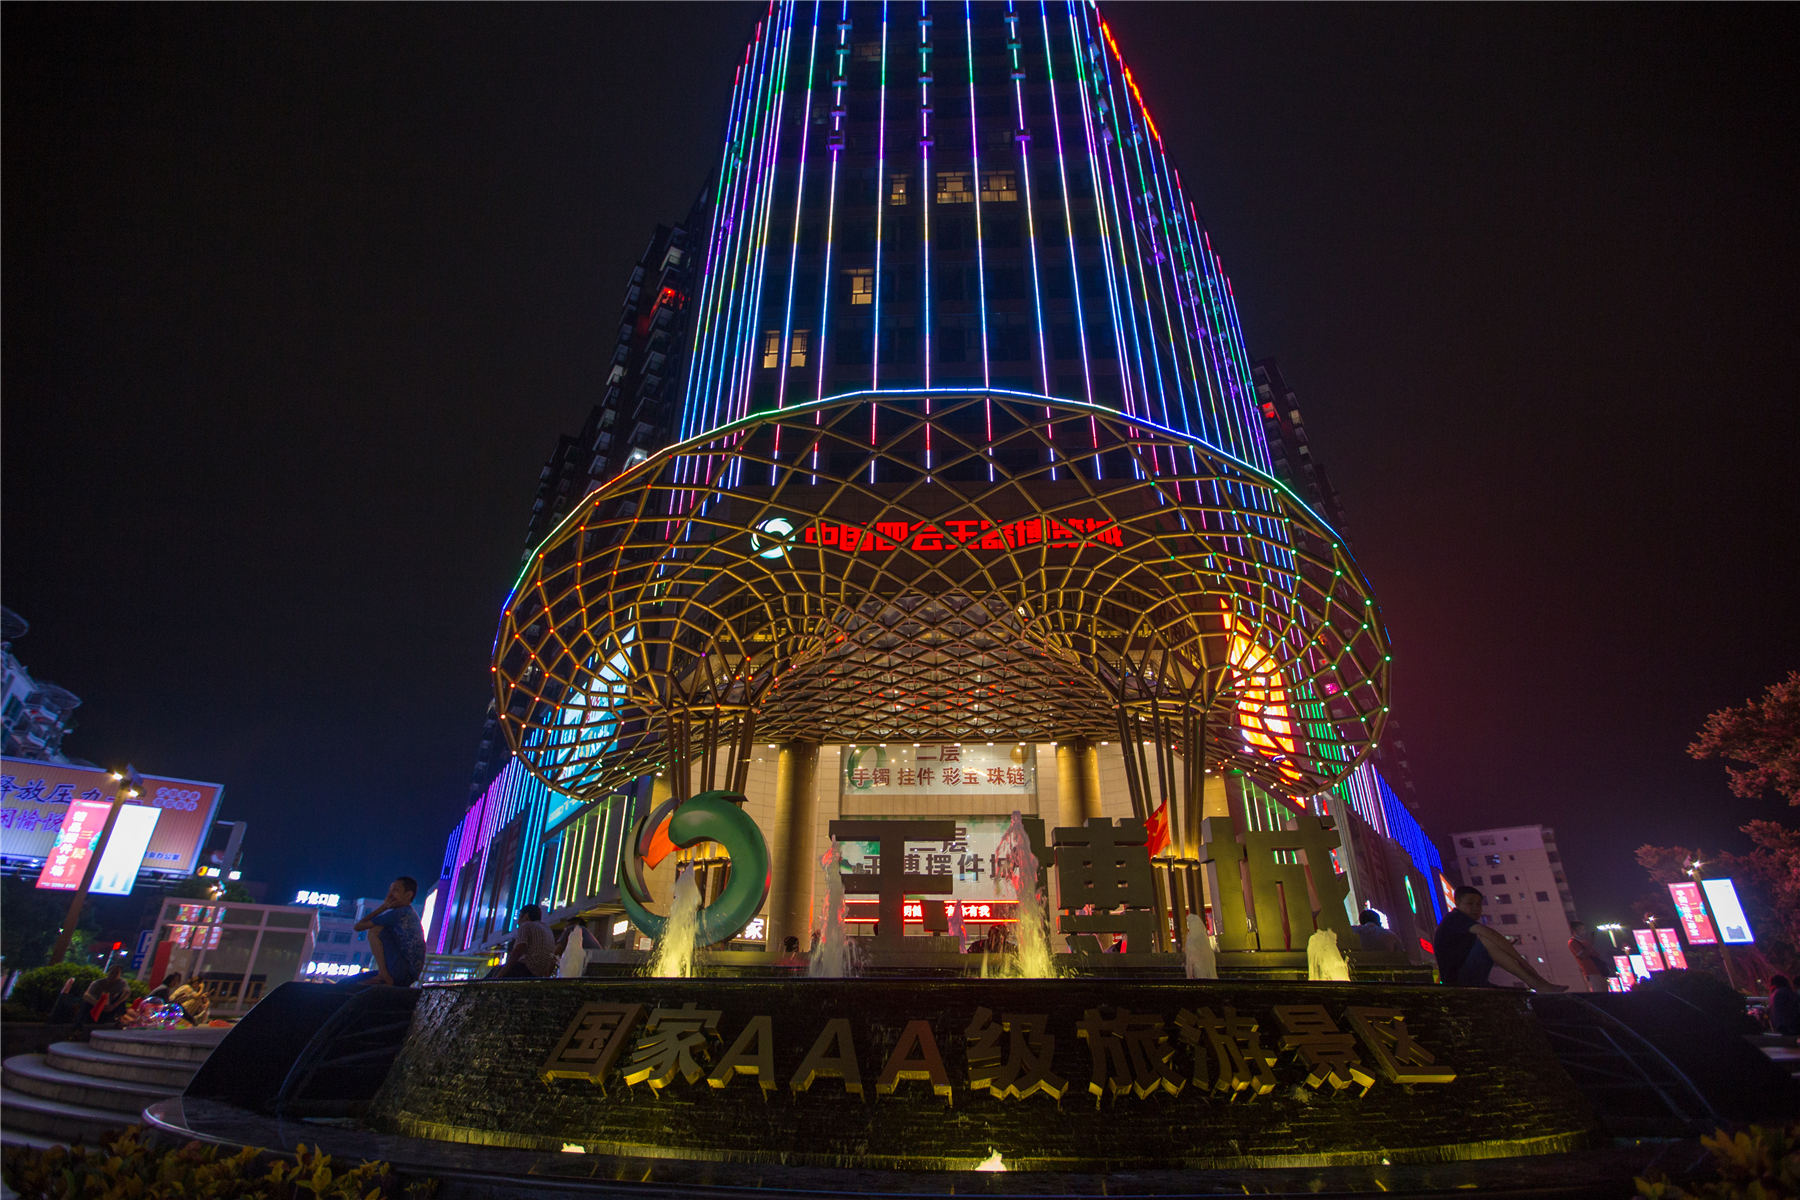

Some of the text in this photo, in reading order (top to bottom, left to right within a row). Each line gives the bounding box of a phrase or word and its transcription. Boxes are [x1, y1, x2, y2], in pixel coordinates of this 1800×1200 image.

[804, 517, 1124, 552] 中国四会玉器博览城
[916, 744, 961, 763] 二层
[851, 766, 1026, 787] 手镯 挂件 彩宝 珠链
[538, 1000, 1458, 1098] 国家AAA级旅游景区
